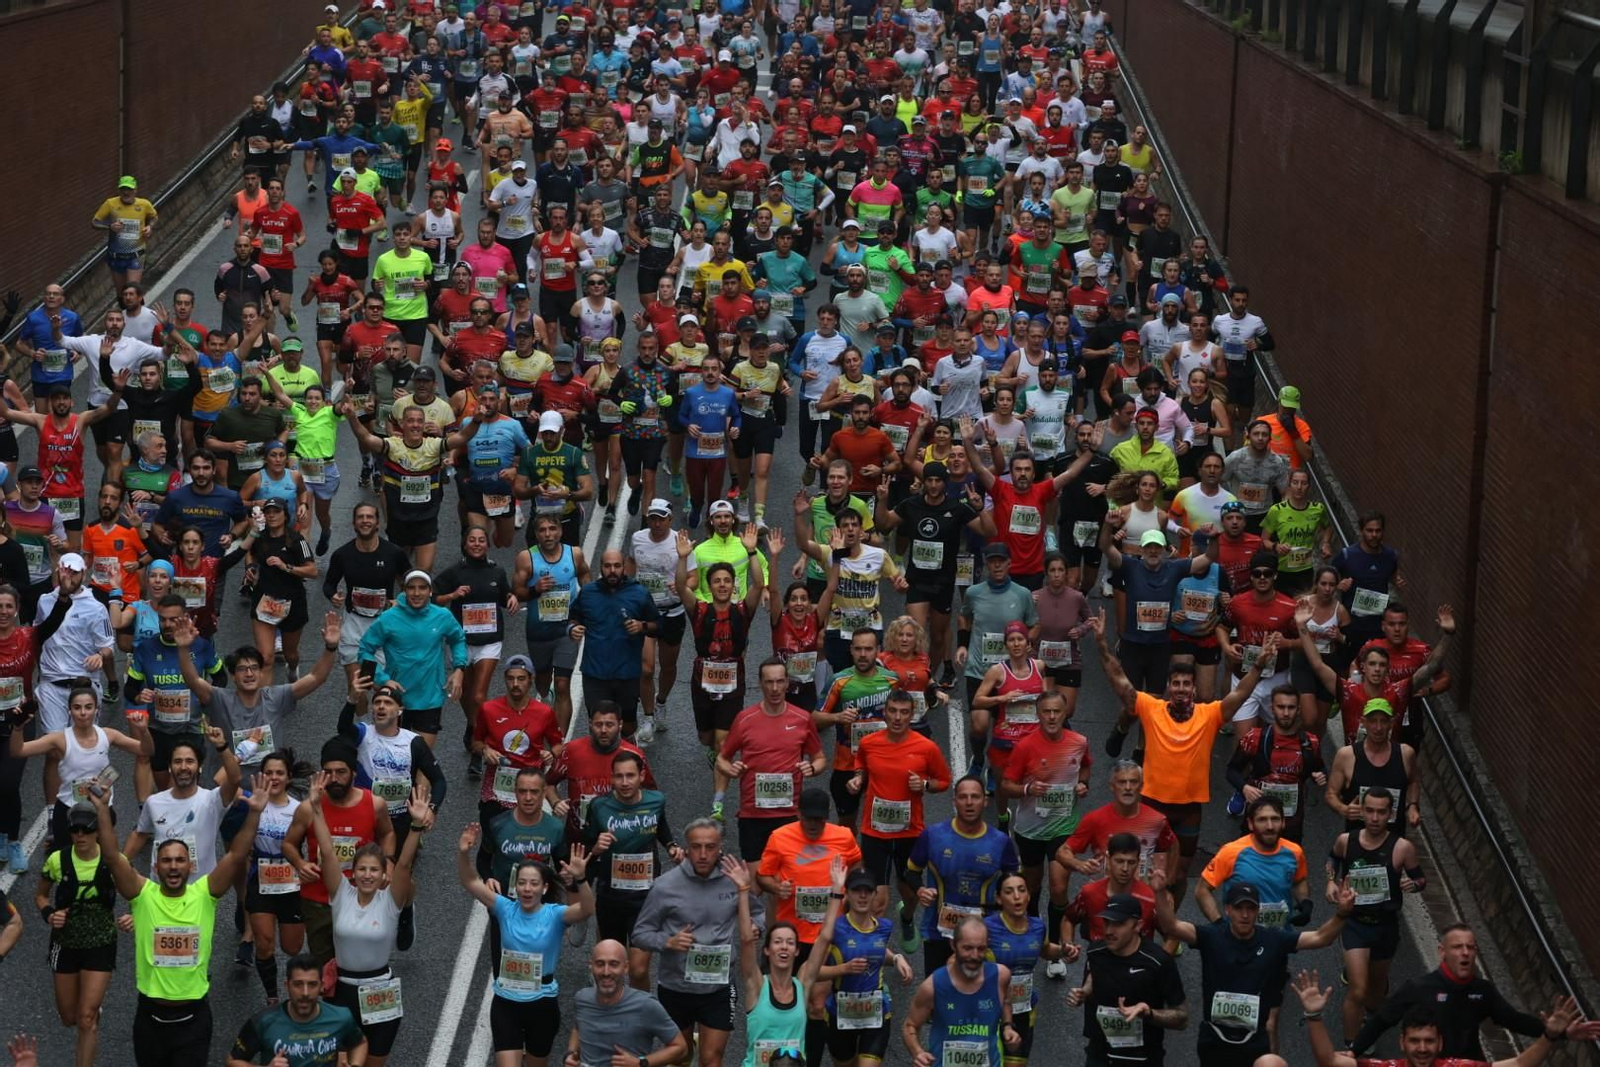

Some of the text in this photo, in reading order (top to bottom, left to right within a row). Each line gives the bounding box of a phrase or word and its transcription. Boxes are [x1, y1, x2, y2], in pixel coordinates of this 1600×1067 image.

[536, 456, 566, 466] POPEYE
[1016, 513, 1036, 523] 7107
[1141, 609, 1163, 619] 4482
[987, 641, 1003, 651] 973
[154, 674, 185, 684] TUSSA
[706, 669, 730, 680] 6106
[379, 785, 403, 795] 7692
[758, 782, 787, 793] 10258
[618, 862, 645, 874] 4900
[1353, 877, 1379, 890] 7112
[802, 896, 829, 908] 8394
[159, 937, 188, 949] 5361
[694, 955, 722, 967] 6875
[1215, 1002, 1252, 1016] 10069
[948, 1025, 989, 1036] TUSSAM
[947, 1051, 984, 1065] 10402
